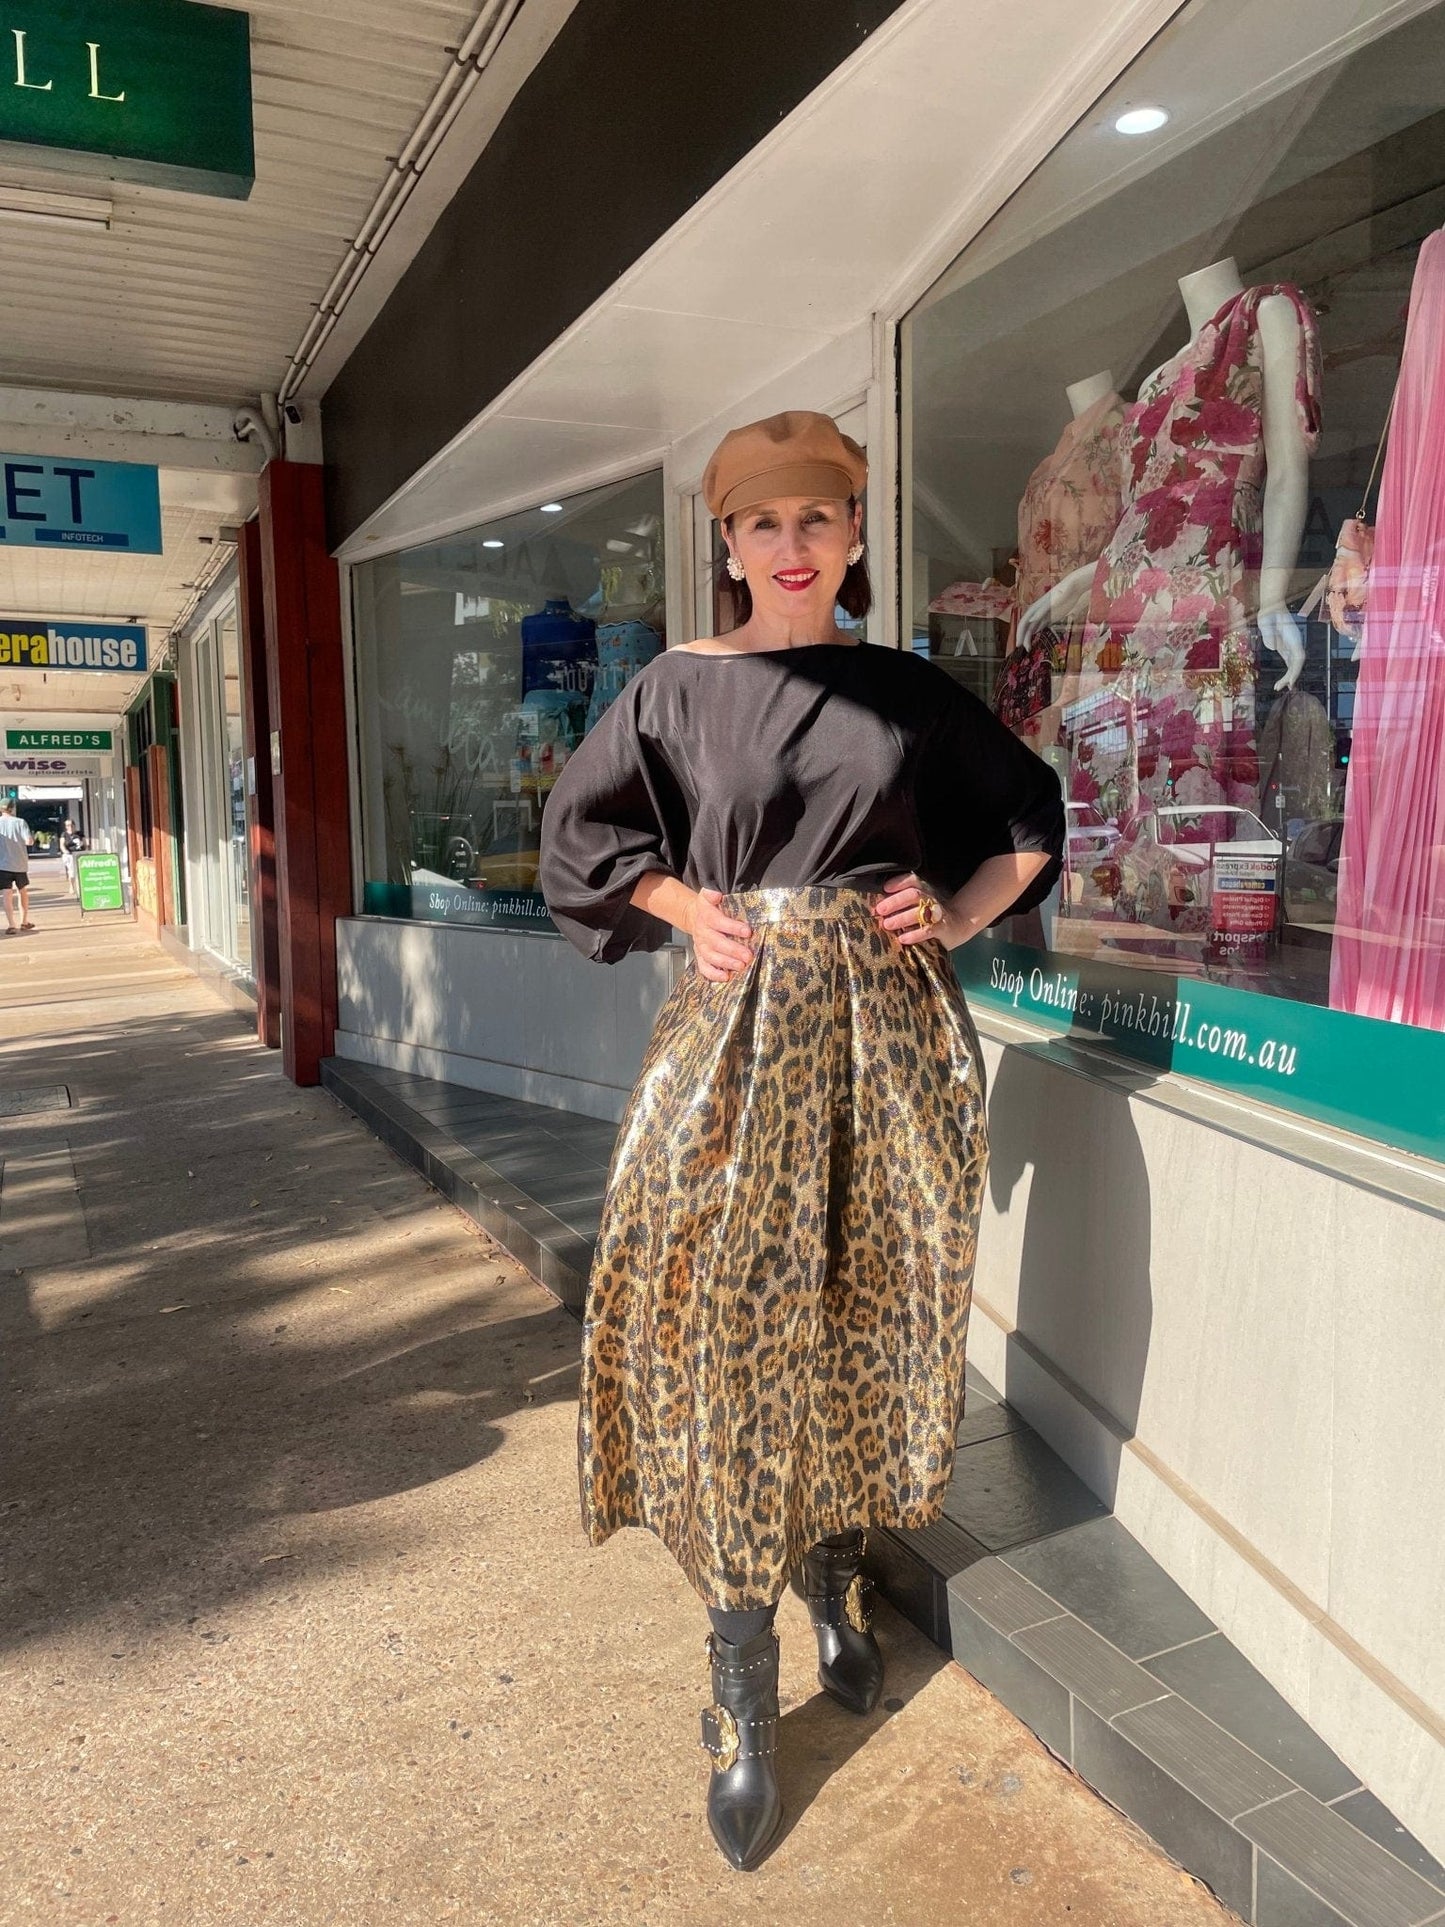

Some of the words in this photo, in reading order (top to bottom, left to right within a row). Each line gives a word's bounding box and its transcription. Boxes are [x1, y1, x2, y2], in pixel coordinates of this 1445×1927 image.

[5, 463, 95, 524] ET
[61, 532, 104, 543] INFOTECH
[19, 735, 100, 746] ALFRED'S
[4, 757, 67, 770] wise
[429, 892, 451, 915] Shop
[453, 894, 489, 912] Online:
[990, 956, 1024, 1008] Shop
[1029, 967, 1094, 1017] Online:
[1097, 988, 1298, 1076] pinkhill.com.au
